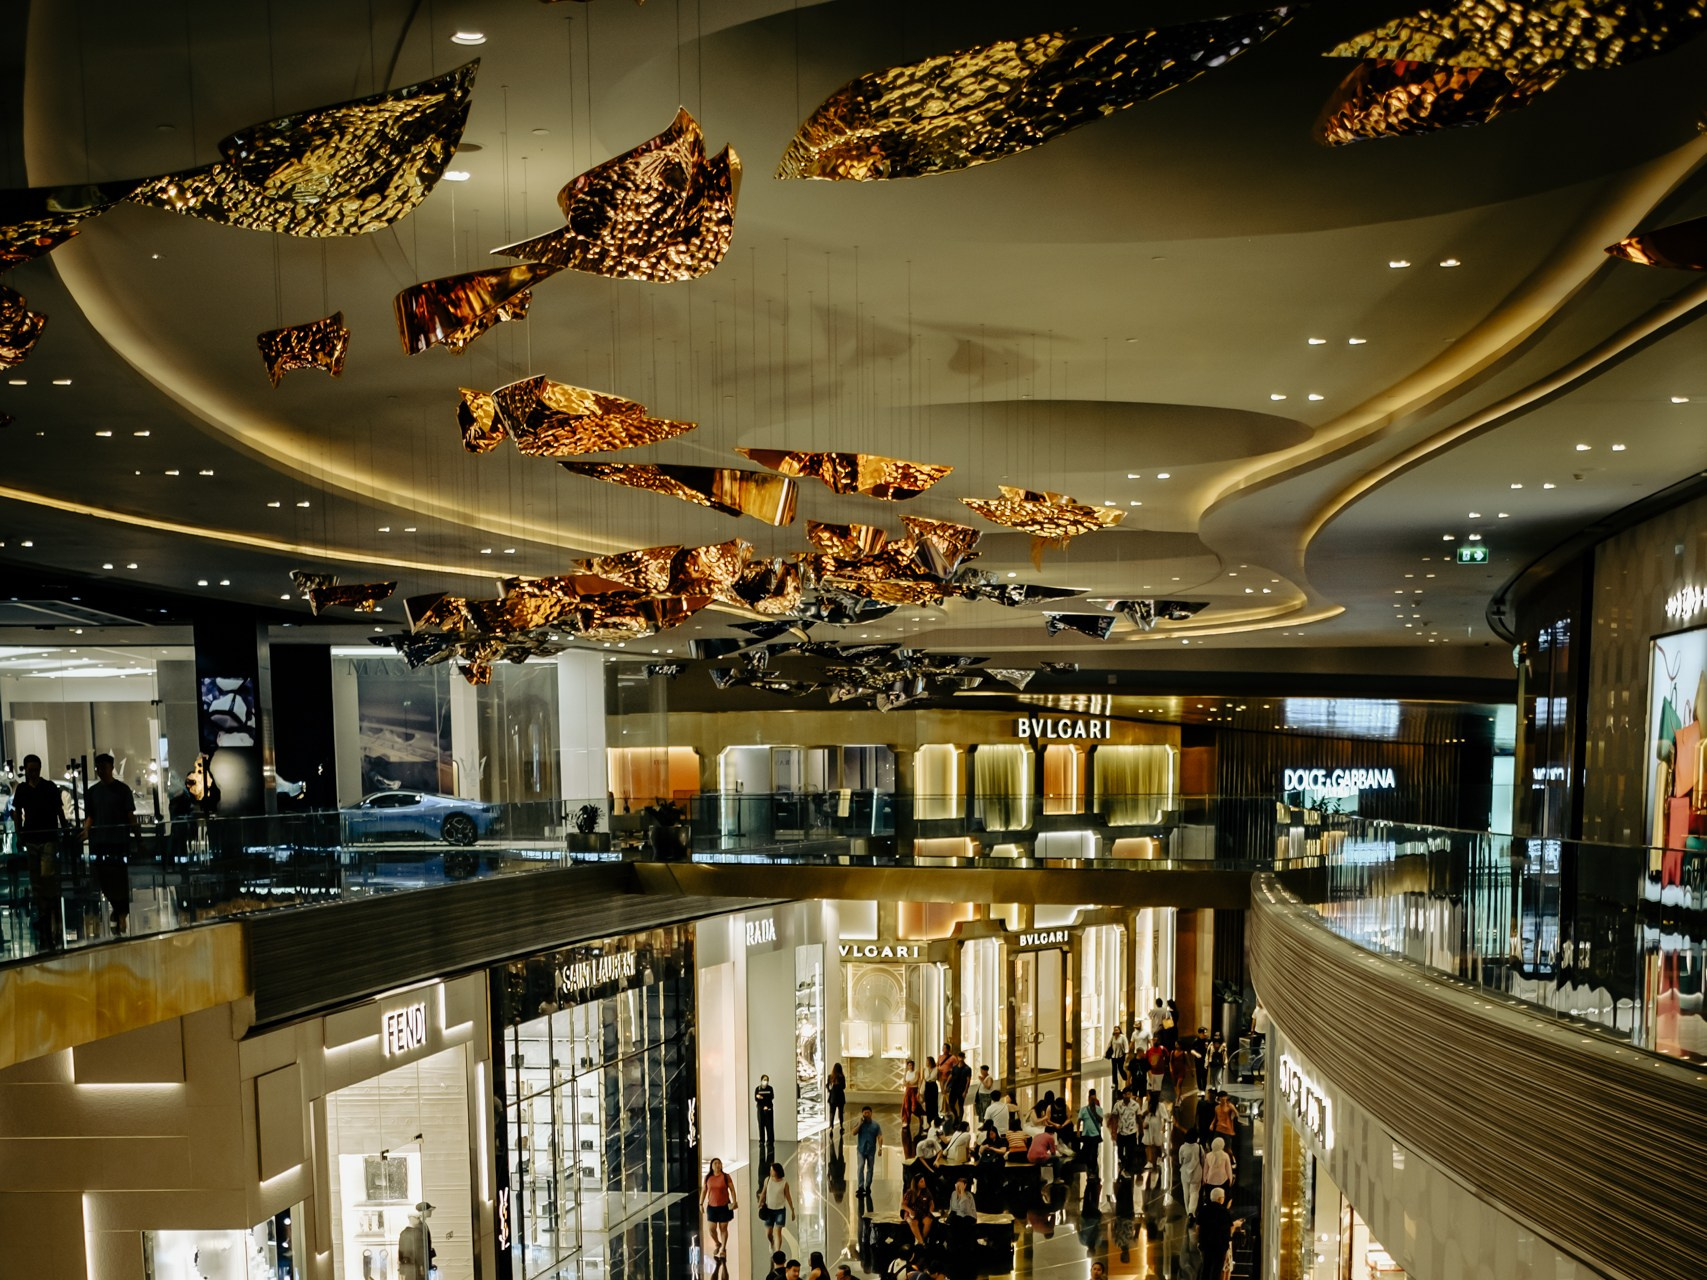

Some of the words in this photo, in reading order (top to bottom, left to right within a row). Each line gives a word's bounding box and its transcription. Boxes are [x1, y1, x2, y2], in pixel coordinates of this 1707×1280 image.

[1018, 717, 1111, 739] BVLGARI
[746, 918, 777, 946] RADA
[1020, 930, 1069, 947] BVLGARI
[839, 945, 919, 958] VLGARI
[386, 1003, 428, 1056] FENDI
